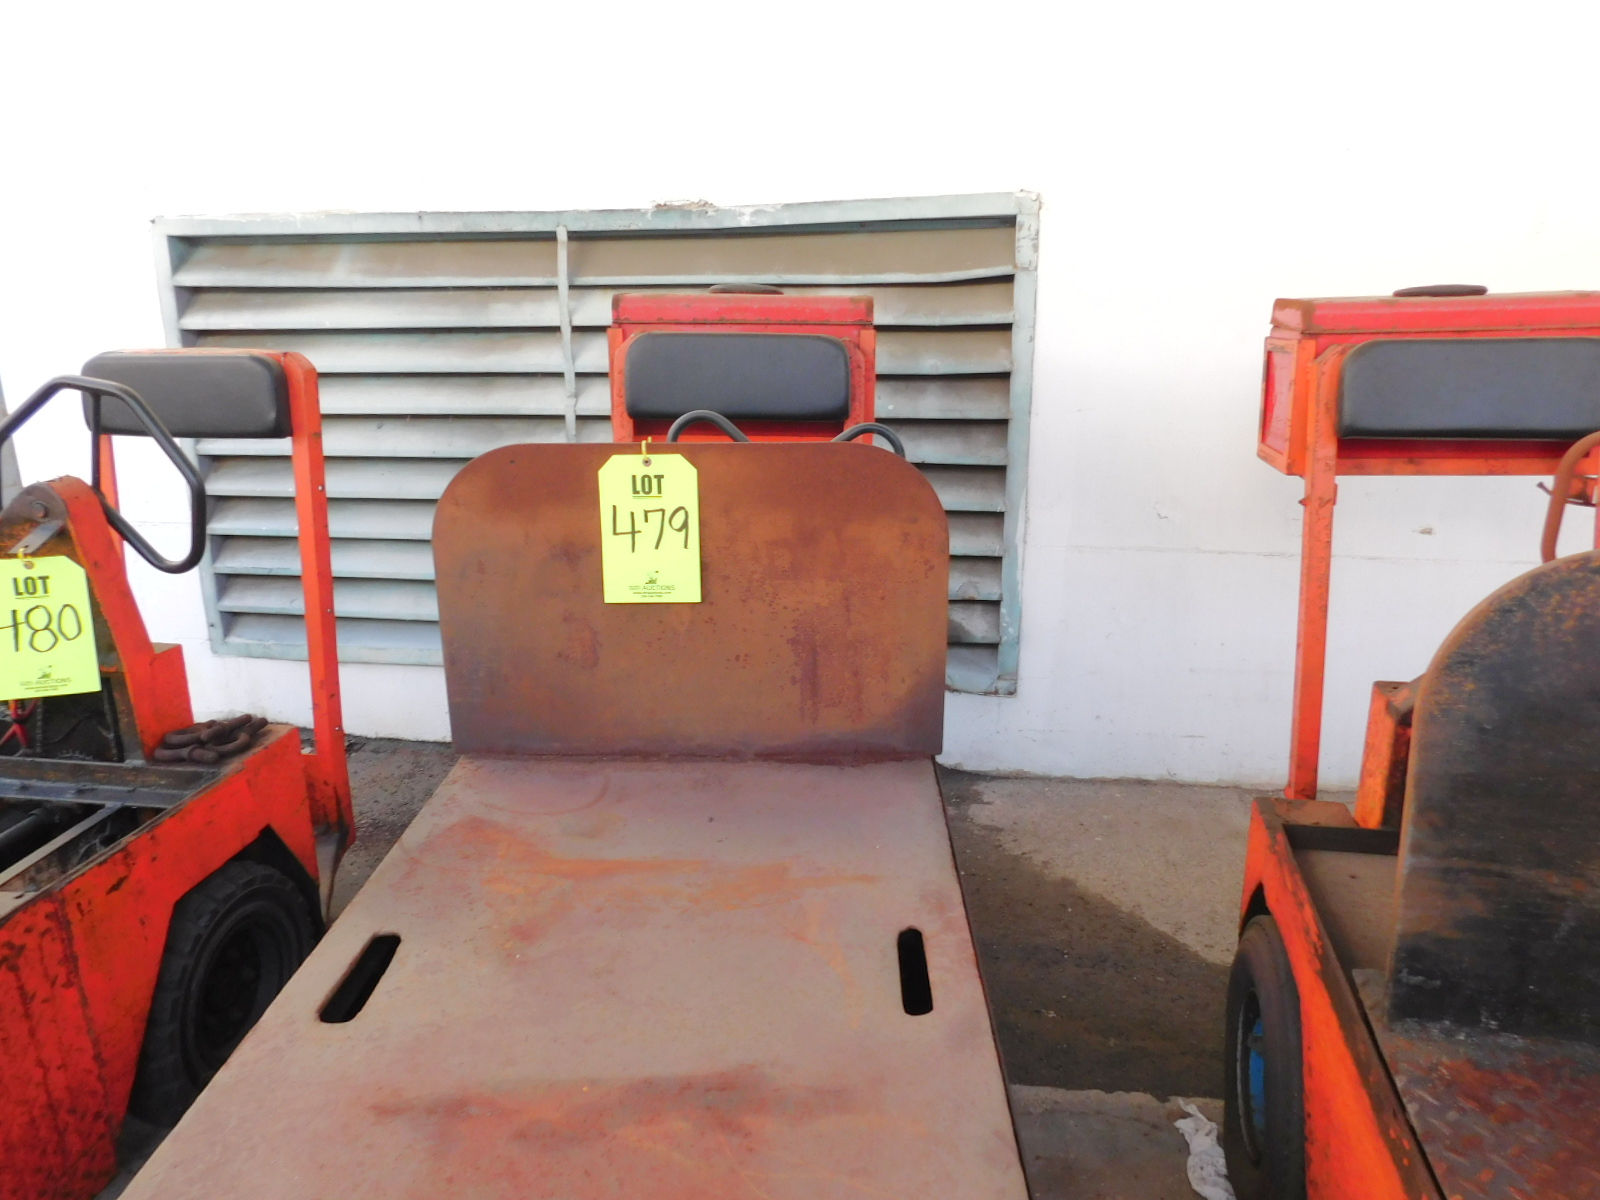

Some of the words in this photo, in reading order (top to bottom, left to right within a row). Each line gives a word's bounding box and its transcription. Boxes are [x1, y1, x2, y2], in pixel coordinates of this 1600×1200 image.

[631, 474, 665, 495] LOT
[612, 504, 690, 553] 479
[12, 575, 50, 596] LOT
